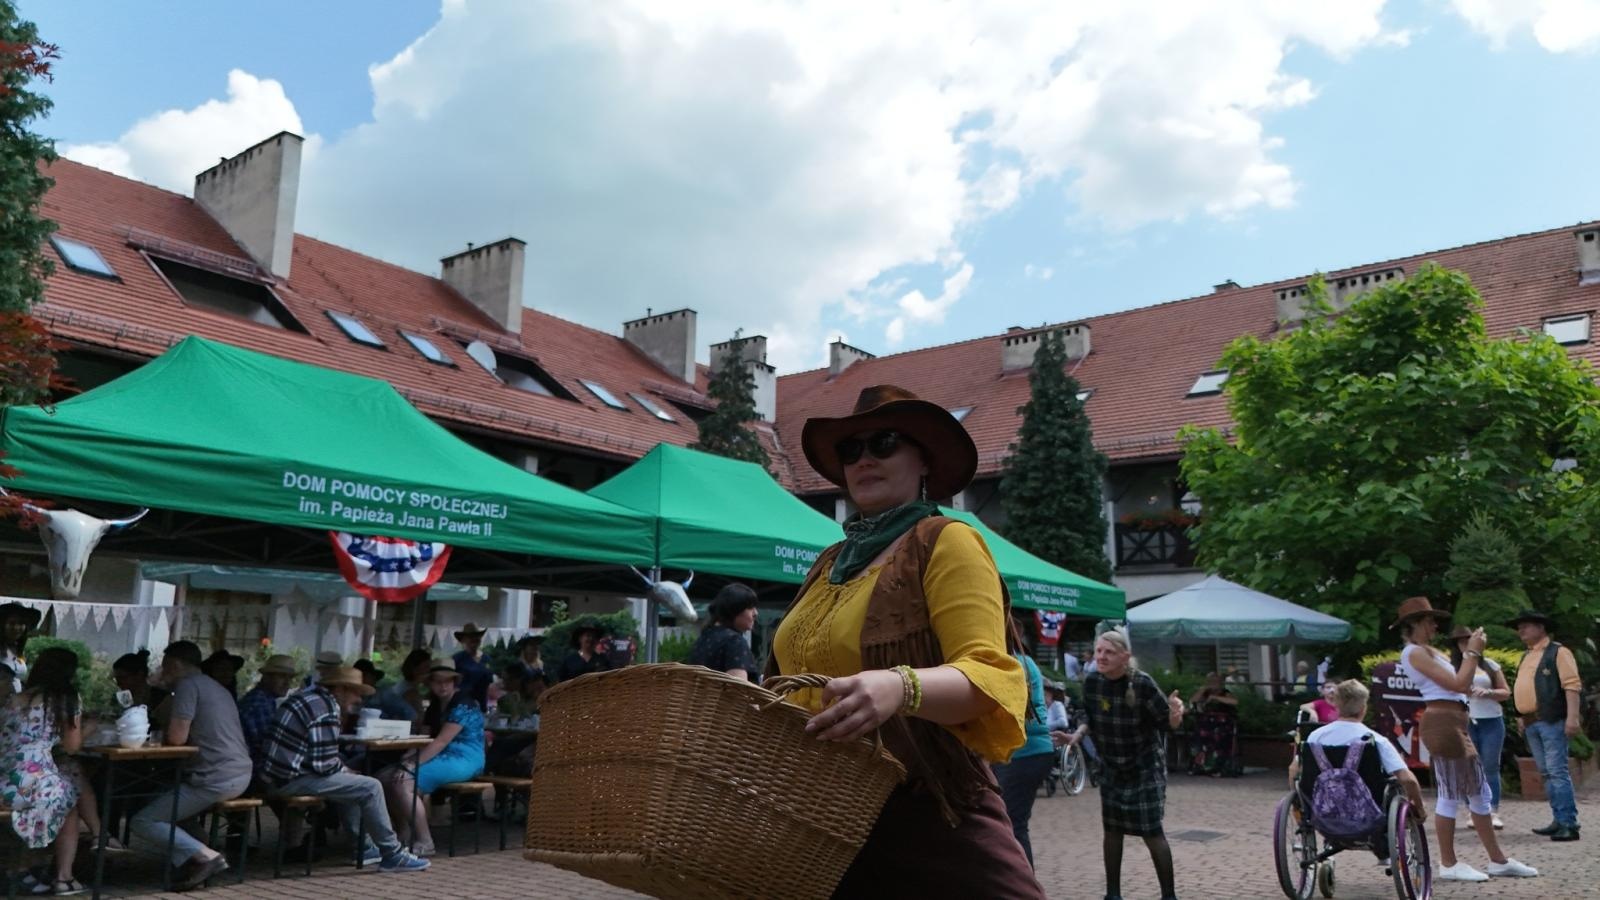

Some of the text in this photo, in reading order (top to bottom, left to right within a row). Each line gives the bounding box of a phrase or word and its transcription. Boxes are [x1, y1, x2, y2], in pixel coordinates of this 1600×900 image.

[283, 471, 508, 519] DOM POMOCY SPOŁECZNEJ
[299, 496, 493, 537] im. Papieża Jana Pawła II
[775, 545, 795, 559] DOM
[783, 561, 796, 574] im.
